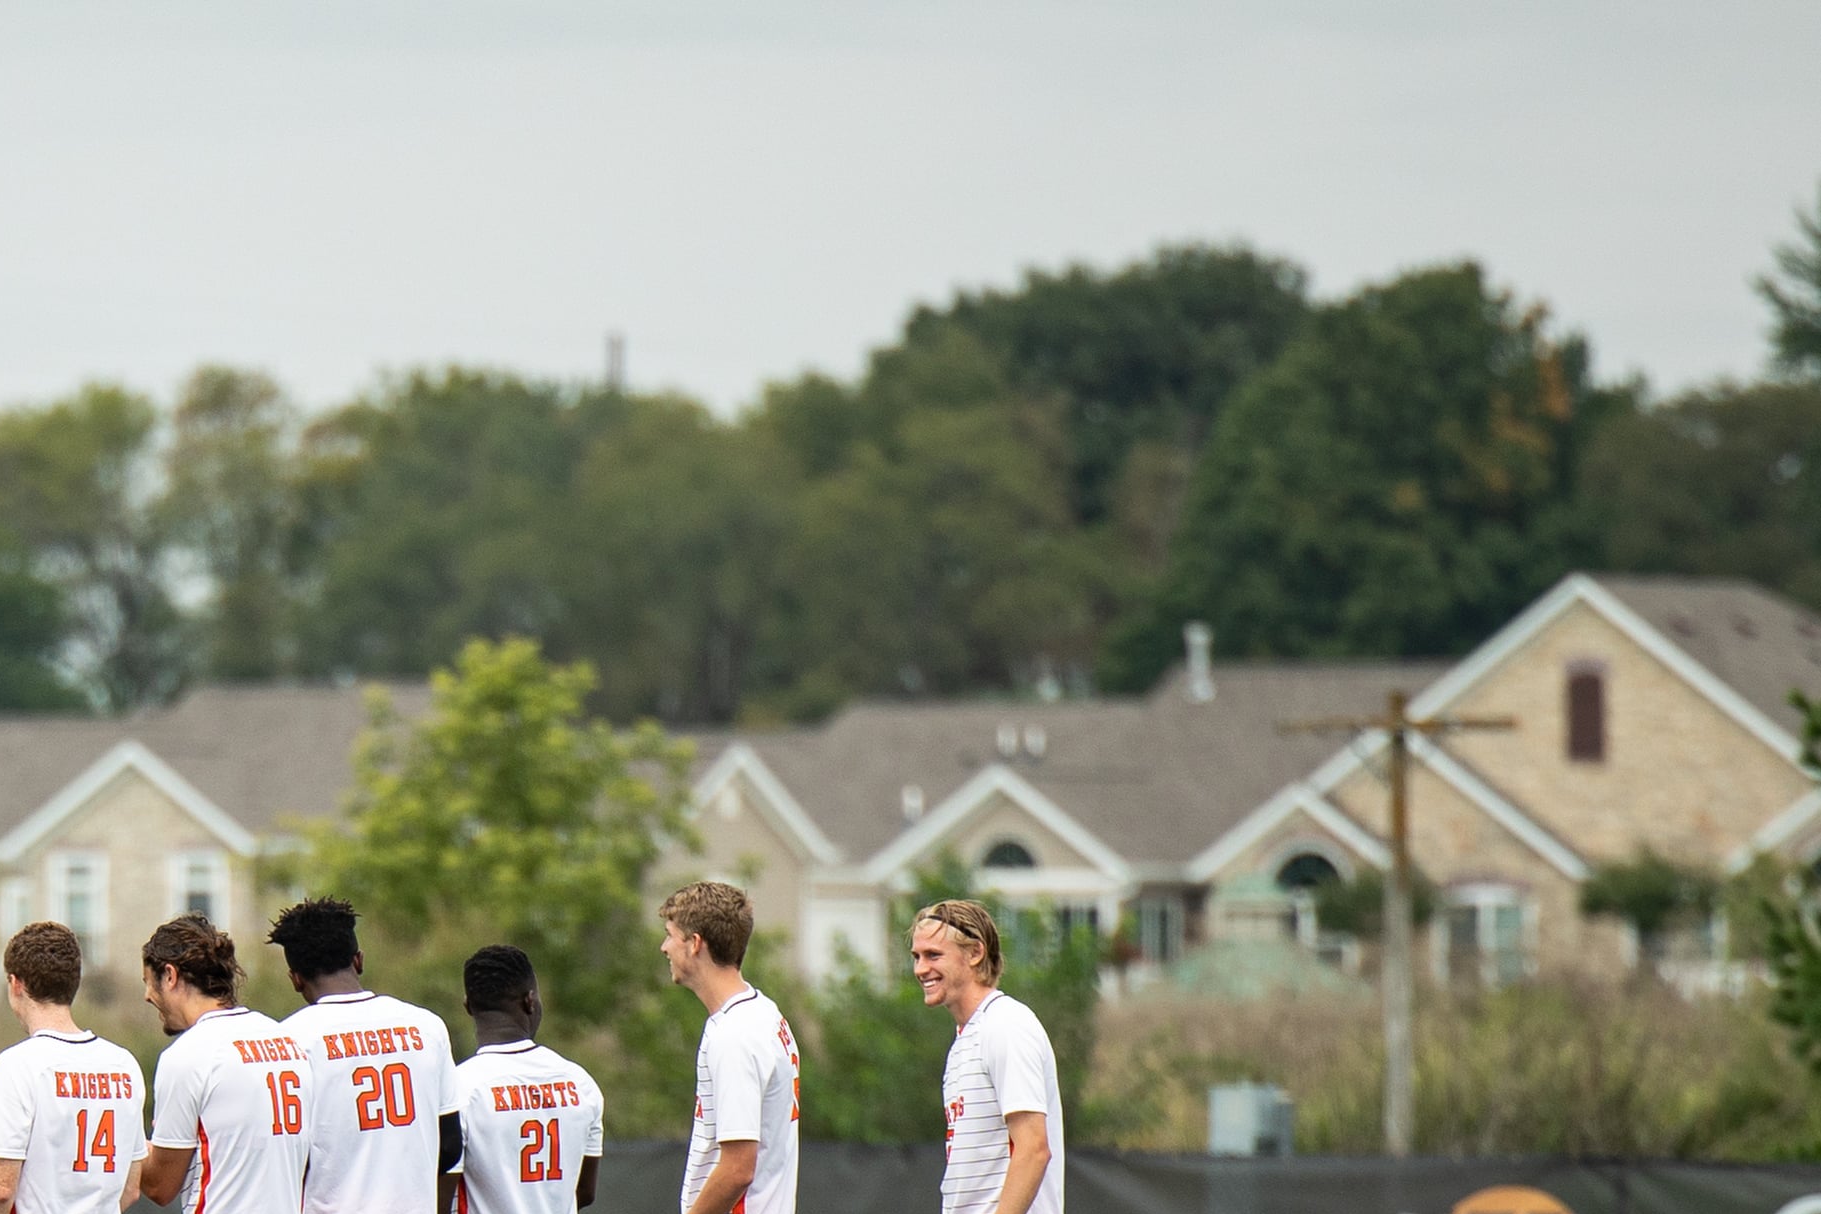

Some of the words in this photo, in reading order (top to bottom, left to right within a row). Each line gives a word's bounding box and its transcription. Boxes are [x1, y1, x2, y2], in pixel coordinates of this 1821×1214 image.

[322, 1027, 424, 1060] KNIGHTS
[54, 1071, 132, 1099] KNIGHTS
[266, 1070, 302, 1136] 16
[352, 1062, 416, 1131] 20
[491, 1081, 580, 1112] KNIGHTS
[72, 1109, 116, 1172] 14
[520, 1118, 563, 1182] 21
